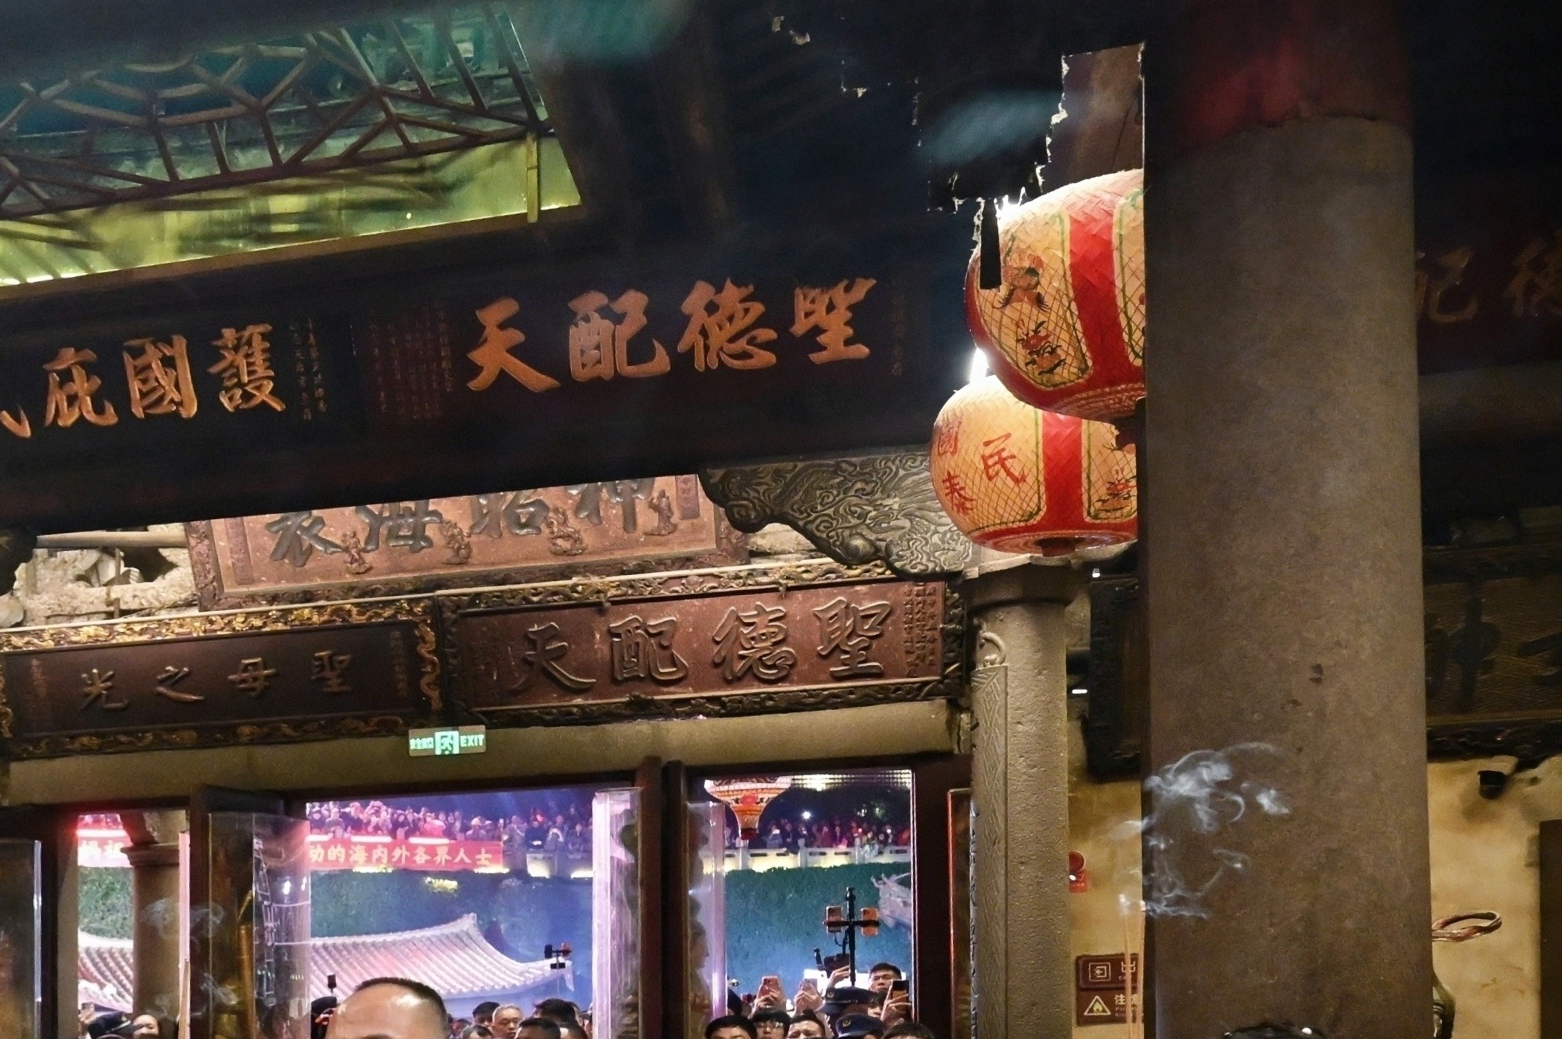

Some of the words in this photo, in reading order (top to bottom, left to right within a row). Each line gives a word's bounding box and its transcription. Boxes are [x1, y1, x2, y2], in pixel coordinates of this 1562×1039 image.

[982, 432, 1027, 484] 民
[512, 597, 892, 690] 聖德配天
[80, 650, 353, 711] 聖母之光
[460, 734, 484, 747] EXIT
[309, 843, 493, 866] 动的海内外各界人士
